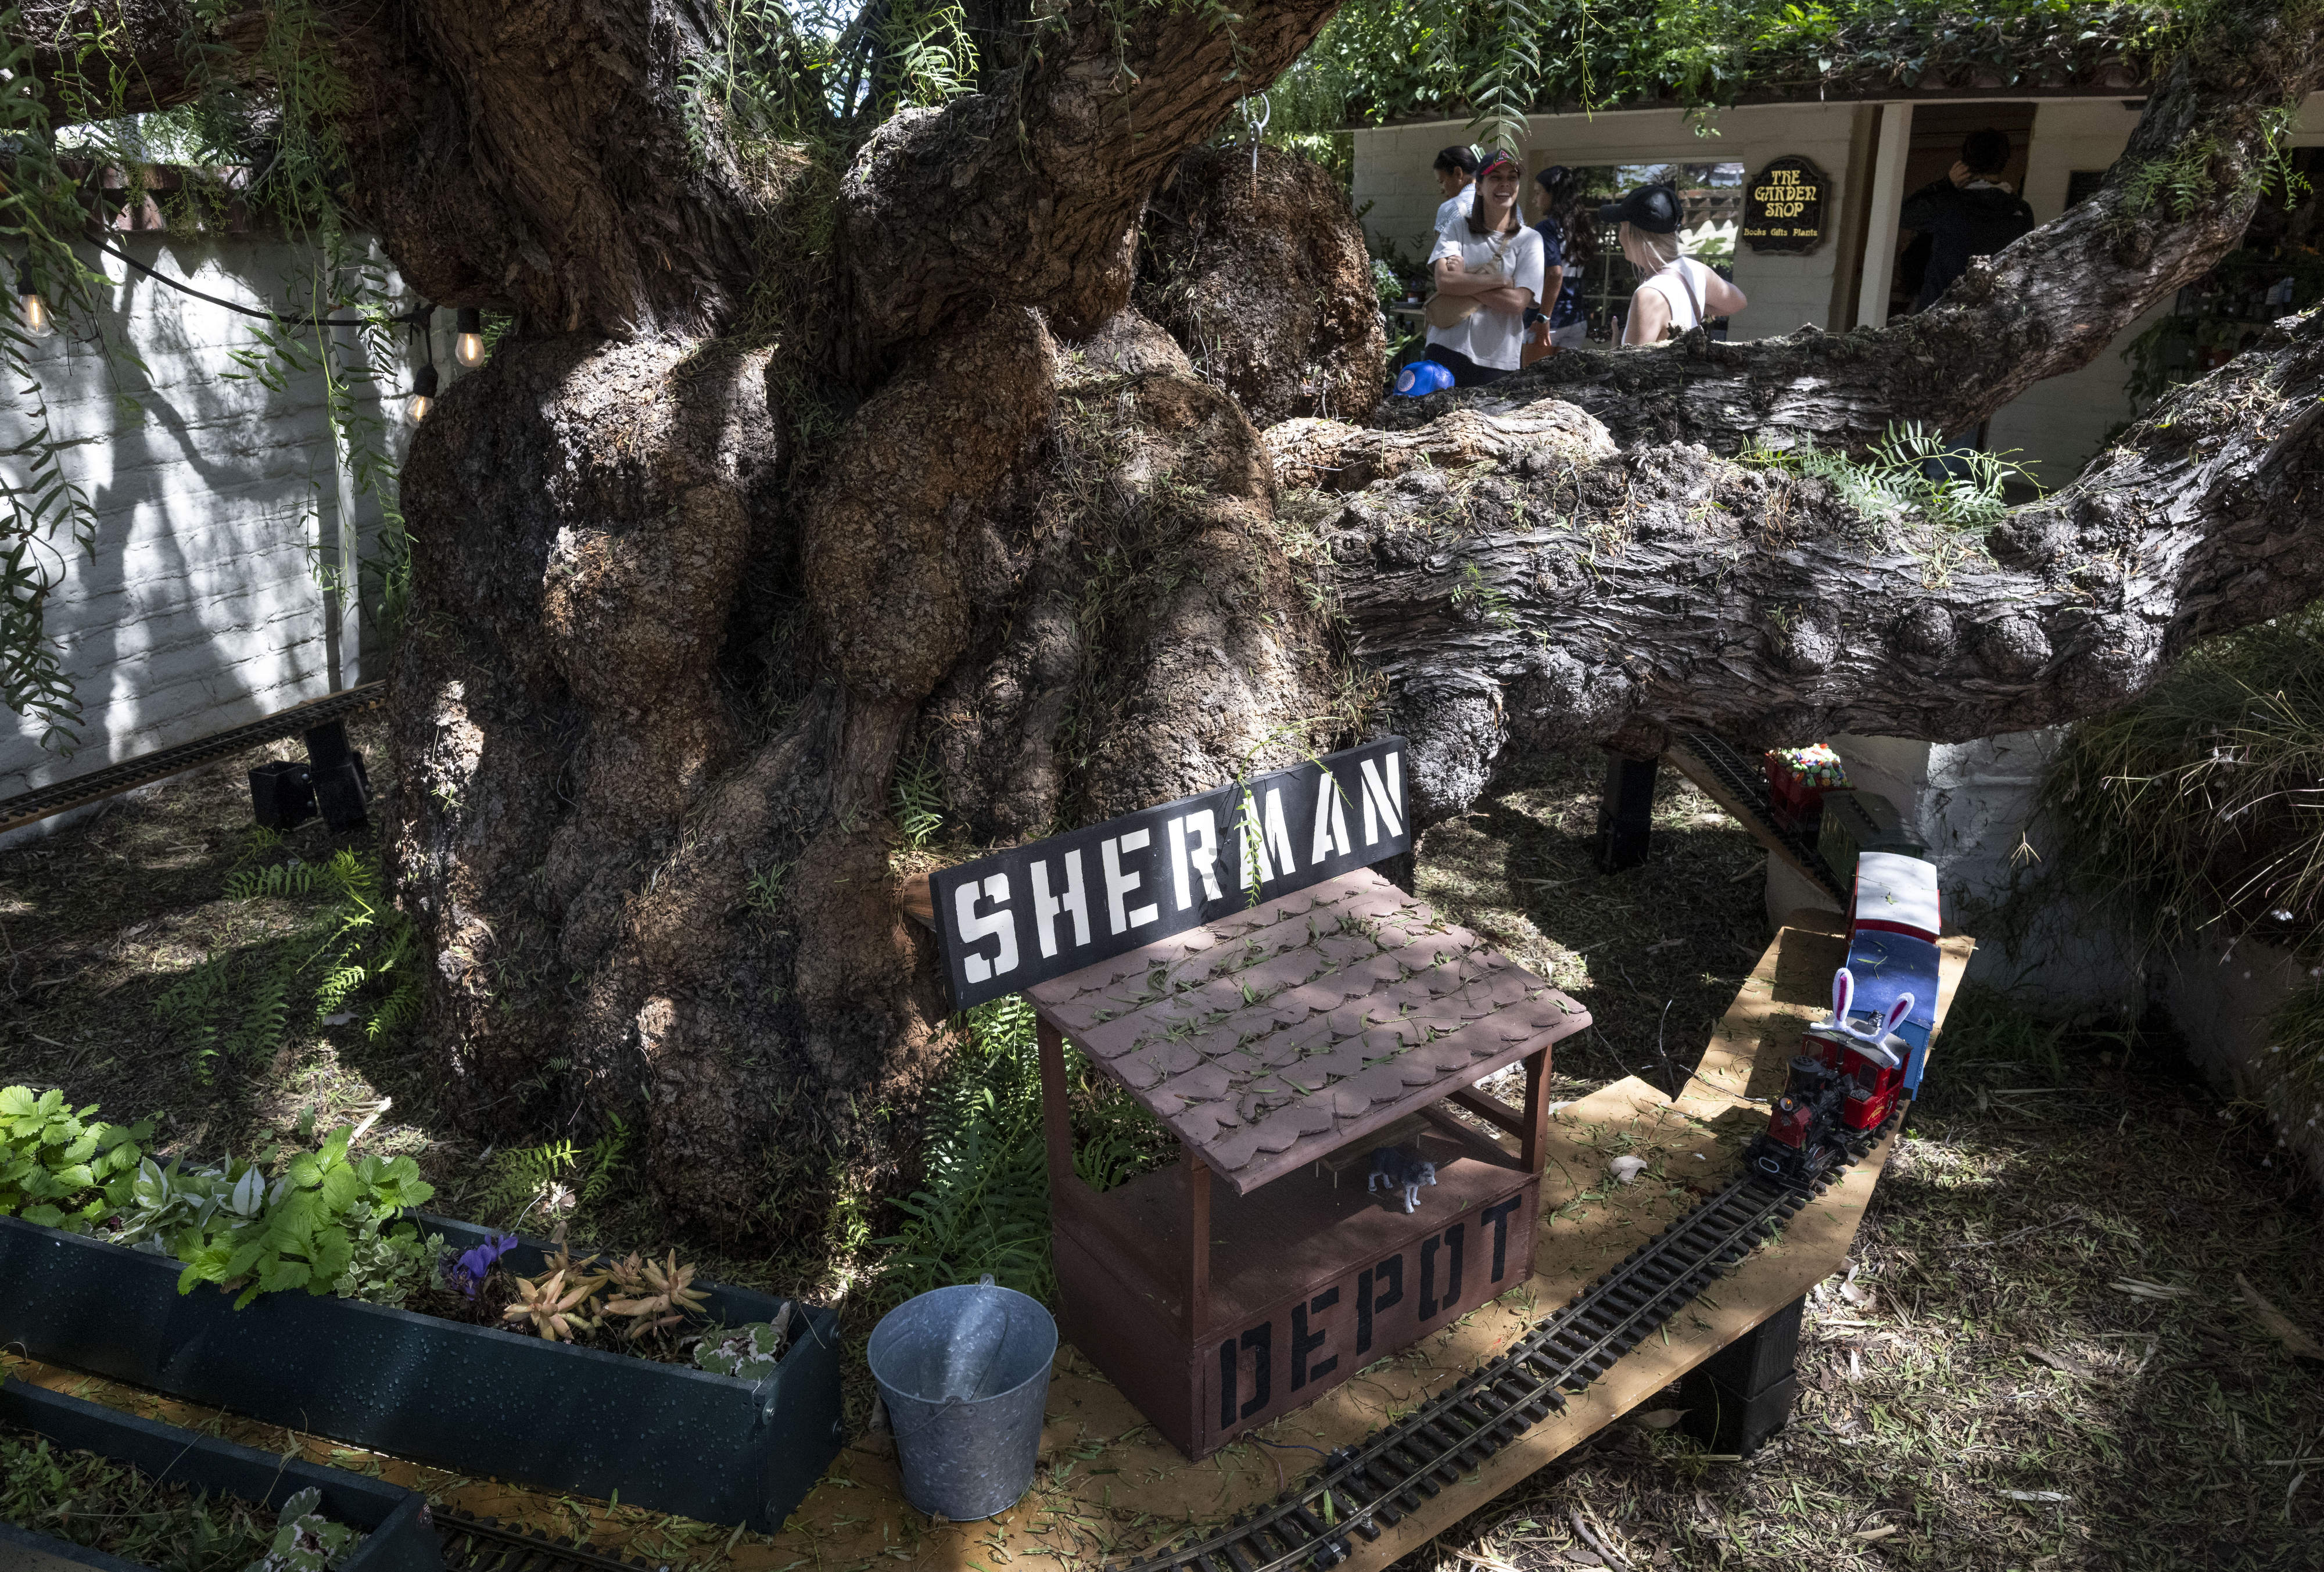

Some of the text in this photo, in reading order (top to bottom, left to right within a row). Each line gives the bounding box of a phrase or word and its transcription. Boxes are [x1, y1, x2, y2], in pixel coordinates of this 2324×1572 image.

[1771, 170, 1801, 186] THE
[1755, 186, 1817, 202] GARDEN
[1765, 202, 1804, 218] SHOP
[1744, 228, 1818, 236] Books Gifts Plants
[954, 751, 1404, 984] SHERMAN
[1220, 1194, 1522, 1431] DEPOT
